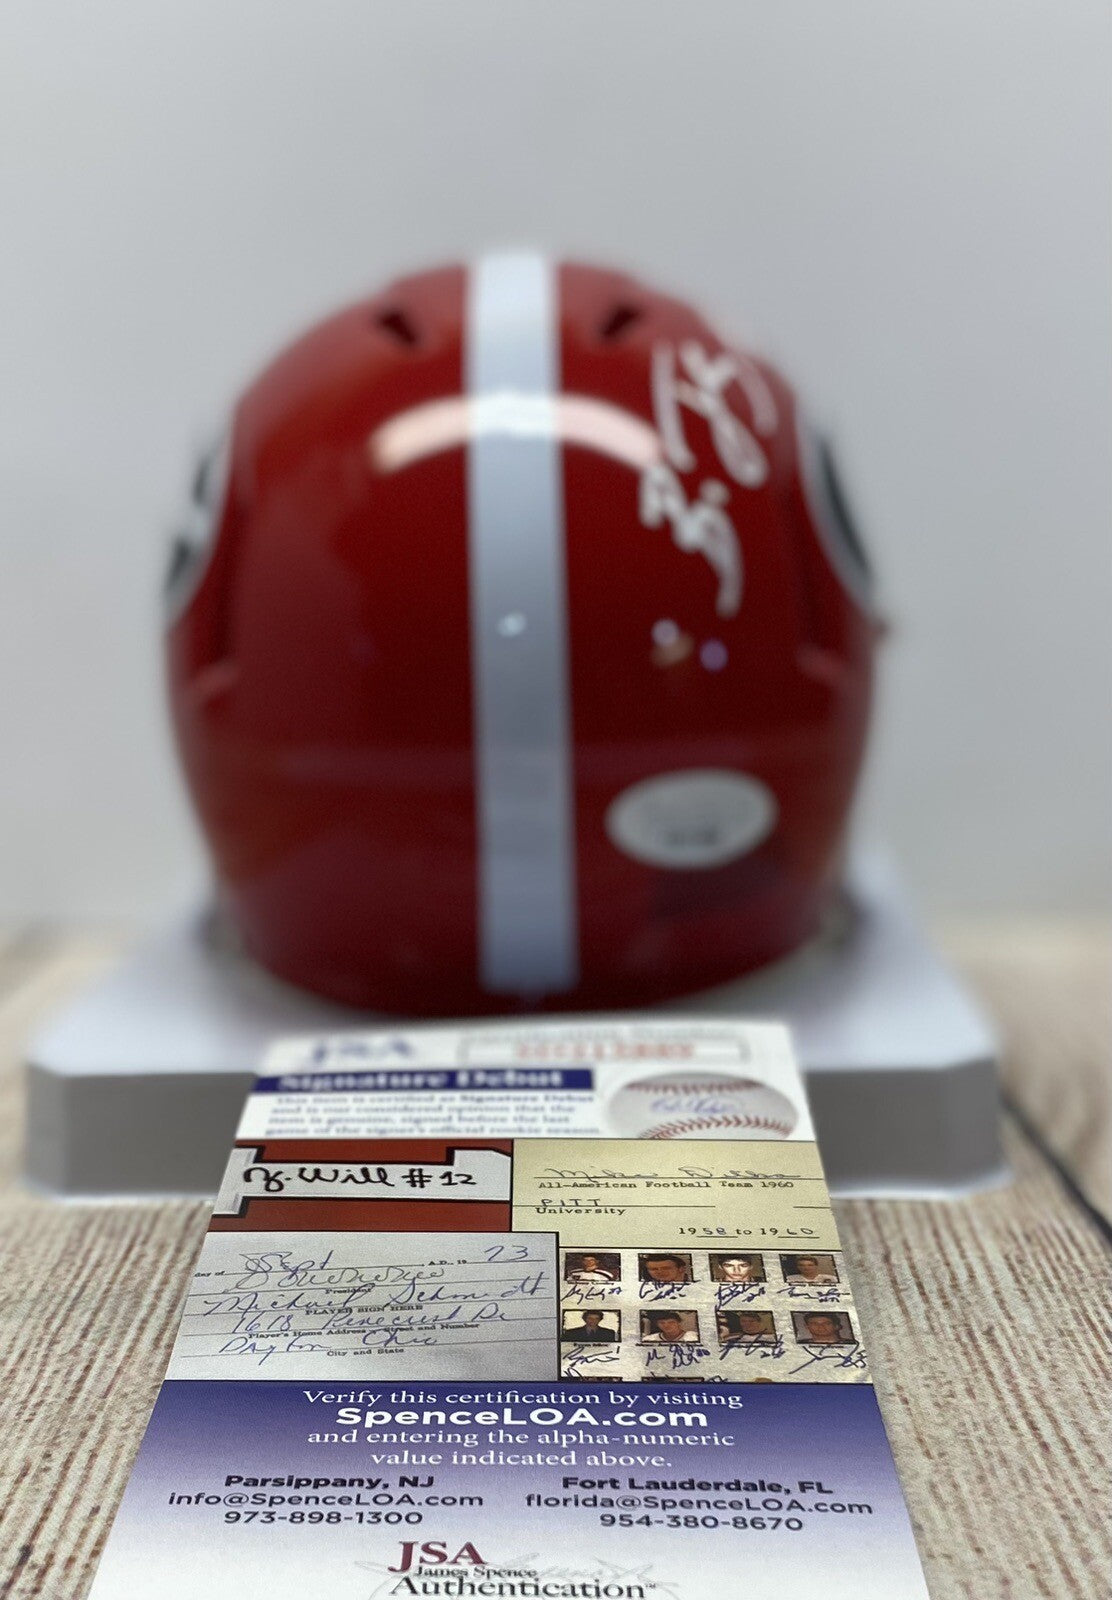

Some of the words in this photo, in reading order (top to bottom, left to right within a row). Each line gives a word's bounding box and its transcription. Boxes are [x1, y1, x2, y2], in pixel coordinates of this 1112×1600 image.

[278, 1071, 448, 1091] Signature
[537, 1180, 638, 1190] All-American
[645, 1180, 712, 1189] Football
[720, 1180, 754, 1188] Team
[761, 1181, 795, 1189] 1960
[535, 1206, 627, 1216] University
[735, 1227, 752, 1236] to
[304, 1307, 353, 1316] PLAYER
[248, 1331, 290, 1340] Player's
[293, 1329, 324, 1337] Home
[326, 1328, 367, 1337] Address
[440, 1323, 481, 1331] Number
[326, 1350, 348, 1358] City
[377, 1347, 405, 1355] State
[302, 1389, 382, 1408] Verify
[388, 1389, 439, 1405] this
[445, 1389, 602, 1406] certification
[607, 1390, 640, 1408] by
[646, 1391, 744, 1409] visiting
[335, 1407, 710, 1428] SpenceLOA.com
[306, 1430, 358, 1445] and
[366, 1430, 480, 1448] entering
[487, 1430, 530, 1445] the
[536, 1431, 736, 1448] alpha-numeric
[371, 1449, 443, 1466] value
[451, 1449, 580, 1467] indicated
[585, 1449, 673, 1468] above.
[224, 1474, 391, 1491] Parsippany,
[398, 1475, 436, 1488] NJ
[561, 1476, 621, 1490] Fort
[628, 1477, 791, 1496] Lauderdale,
[797, 1480, 834, 1495] FL
[168, 1492, 485, 1508] info@SpenceLOA.com
[525, 1492, 874, 1515] florida@SpenceLOA.com
[223, 1510, 424, 1525] 973-898-1300
[599, 1513, 804, 1532] 954-380-8670
[387, 1540, 488, 1573] JSA
[414, 1565, 468, 1578] James
[473, 1565, 539, 1579] Spence
